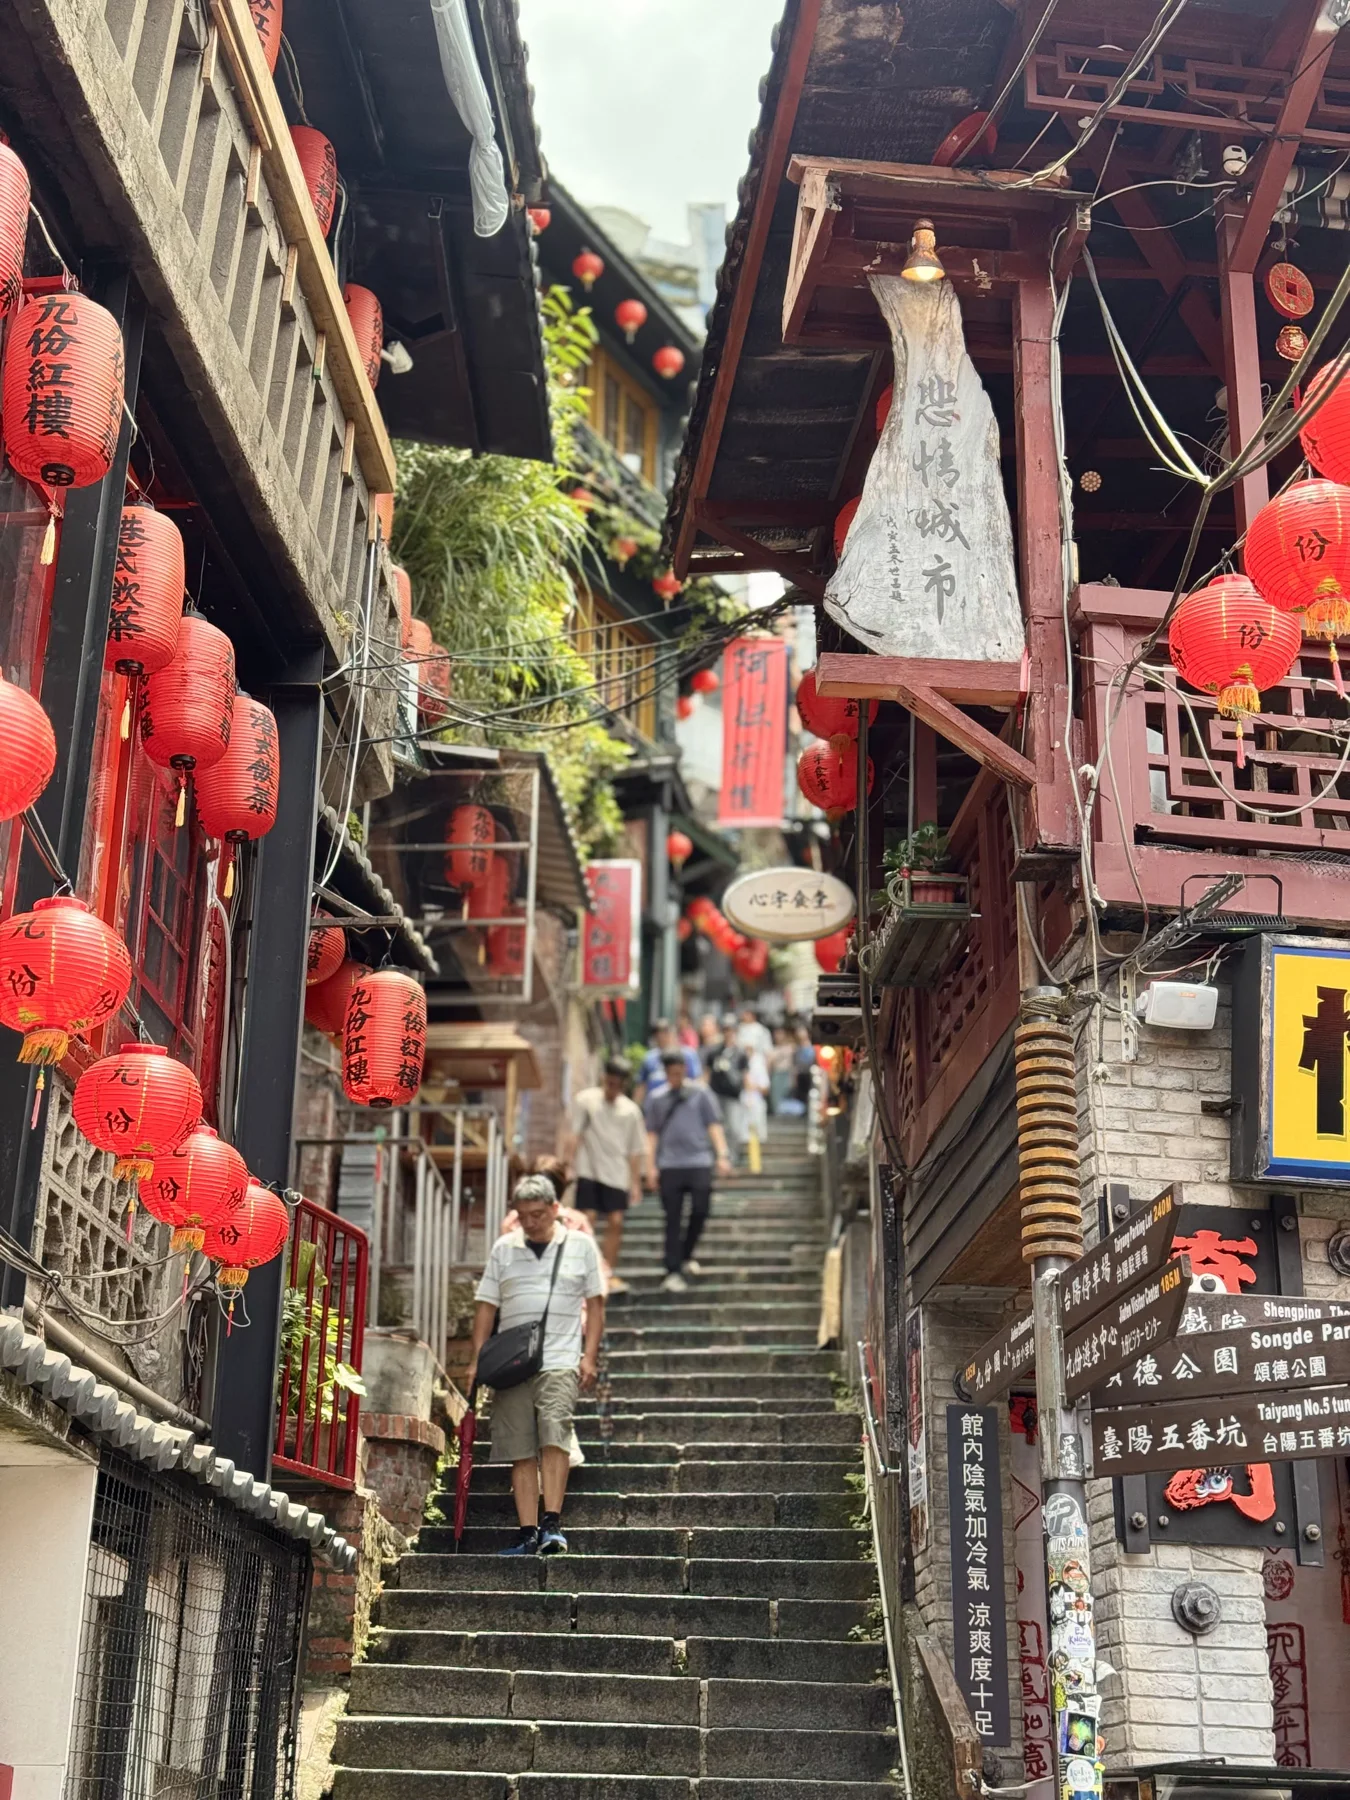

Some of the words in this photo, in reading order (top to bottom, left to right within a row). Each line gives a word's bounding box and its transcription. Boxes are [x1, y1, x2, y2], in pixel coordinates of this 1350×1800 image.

[22, 296, 82, 439] 九份紅樓
[913, 374, 971, 625] 悲情城市
[346, 987, 374, 1086] 九份紅樓
[1129, 1219, 1146, 1241] Parking
[1145, 1211, 1153, 1233] Lot
[1153, 1195, 1172, 1222] 240M
[1064, 1252, 1111, 1312] 台陽停車場
[1131, 1294, 1146, 1314] Visitor
[1145, 1284, 1160, 1305] Center
[1160, 1267, 1180, 1294] 185M
[1264, 1302, 1321, 1320] Shengping
[1066, 1325, 1118, 1379] 九份遊客中心
[1251, 1327, 1313, 1349] Songde
[1106, 1346, 1238, 1388] 德公園
[1254, 1356, 1326, 1382] 頌德公園
[1257, 1402, 1303, 1423] Taiyang
[1304, 1397, 1330, 1416] No.5
[1100, 1415, 1247, 1461] 臺陽五番坑
[960, 1413, 990, 1592] 館內陰氣加冷氣
[968, 1601, 995, 1736] 涼爽度十足
